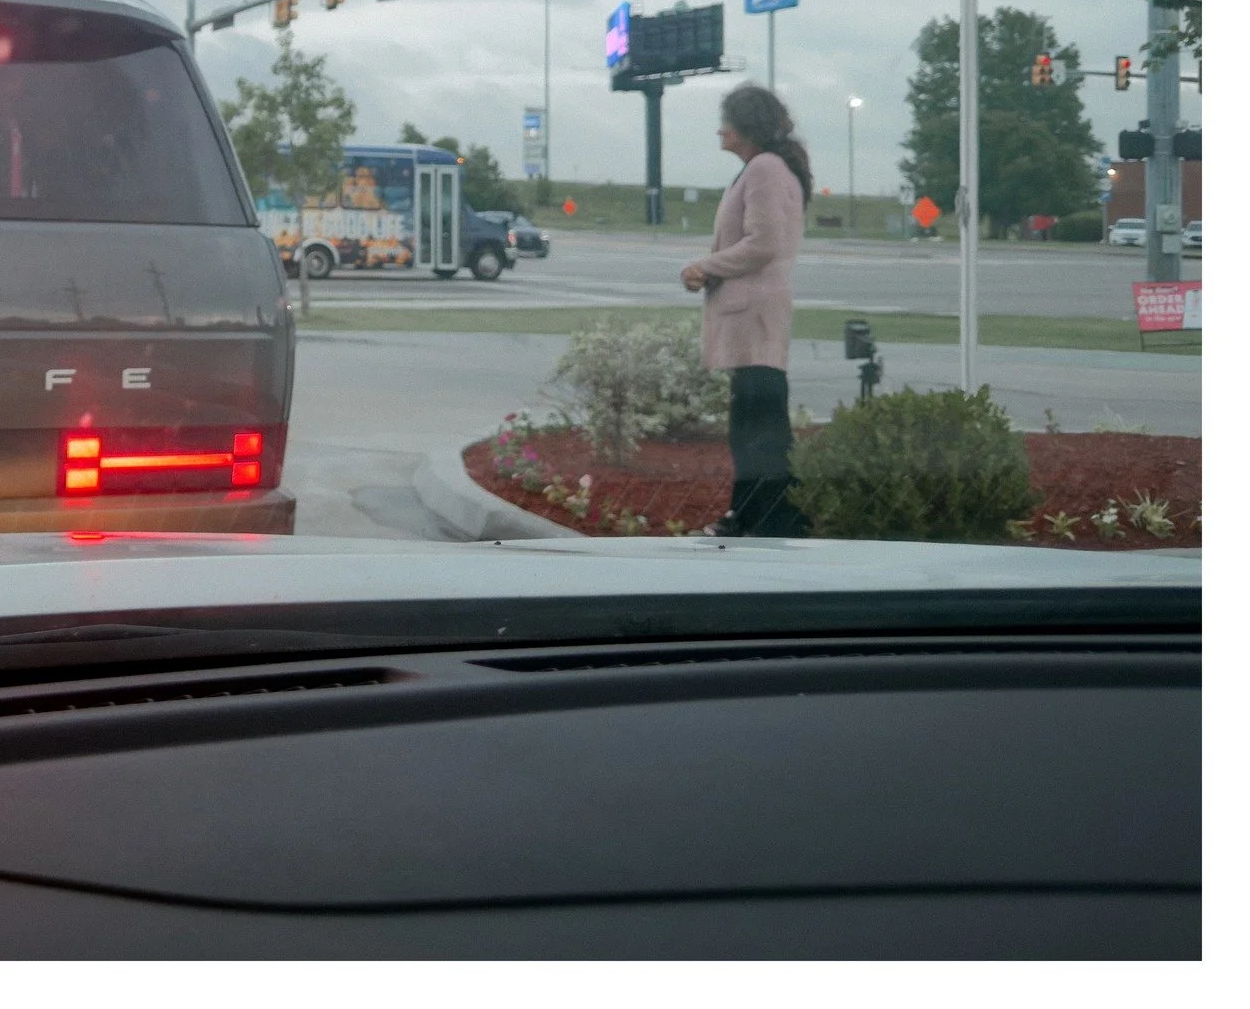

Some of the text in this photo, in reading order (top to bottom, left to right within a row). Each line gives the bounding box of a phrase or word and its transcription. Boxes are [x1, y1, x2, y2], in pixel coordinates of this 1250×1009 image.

[1137, 294, 1183, 306] ORDER
[1138, 304, 1185, 315] AHEAD
[45, 367, 152, 392] FE
